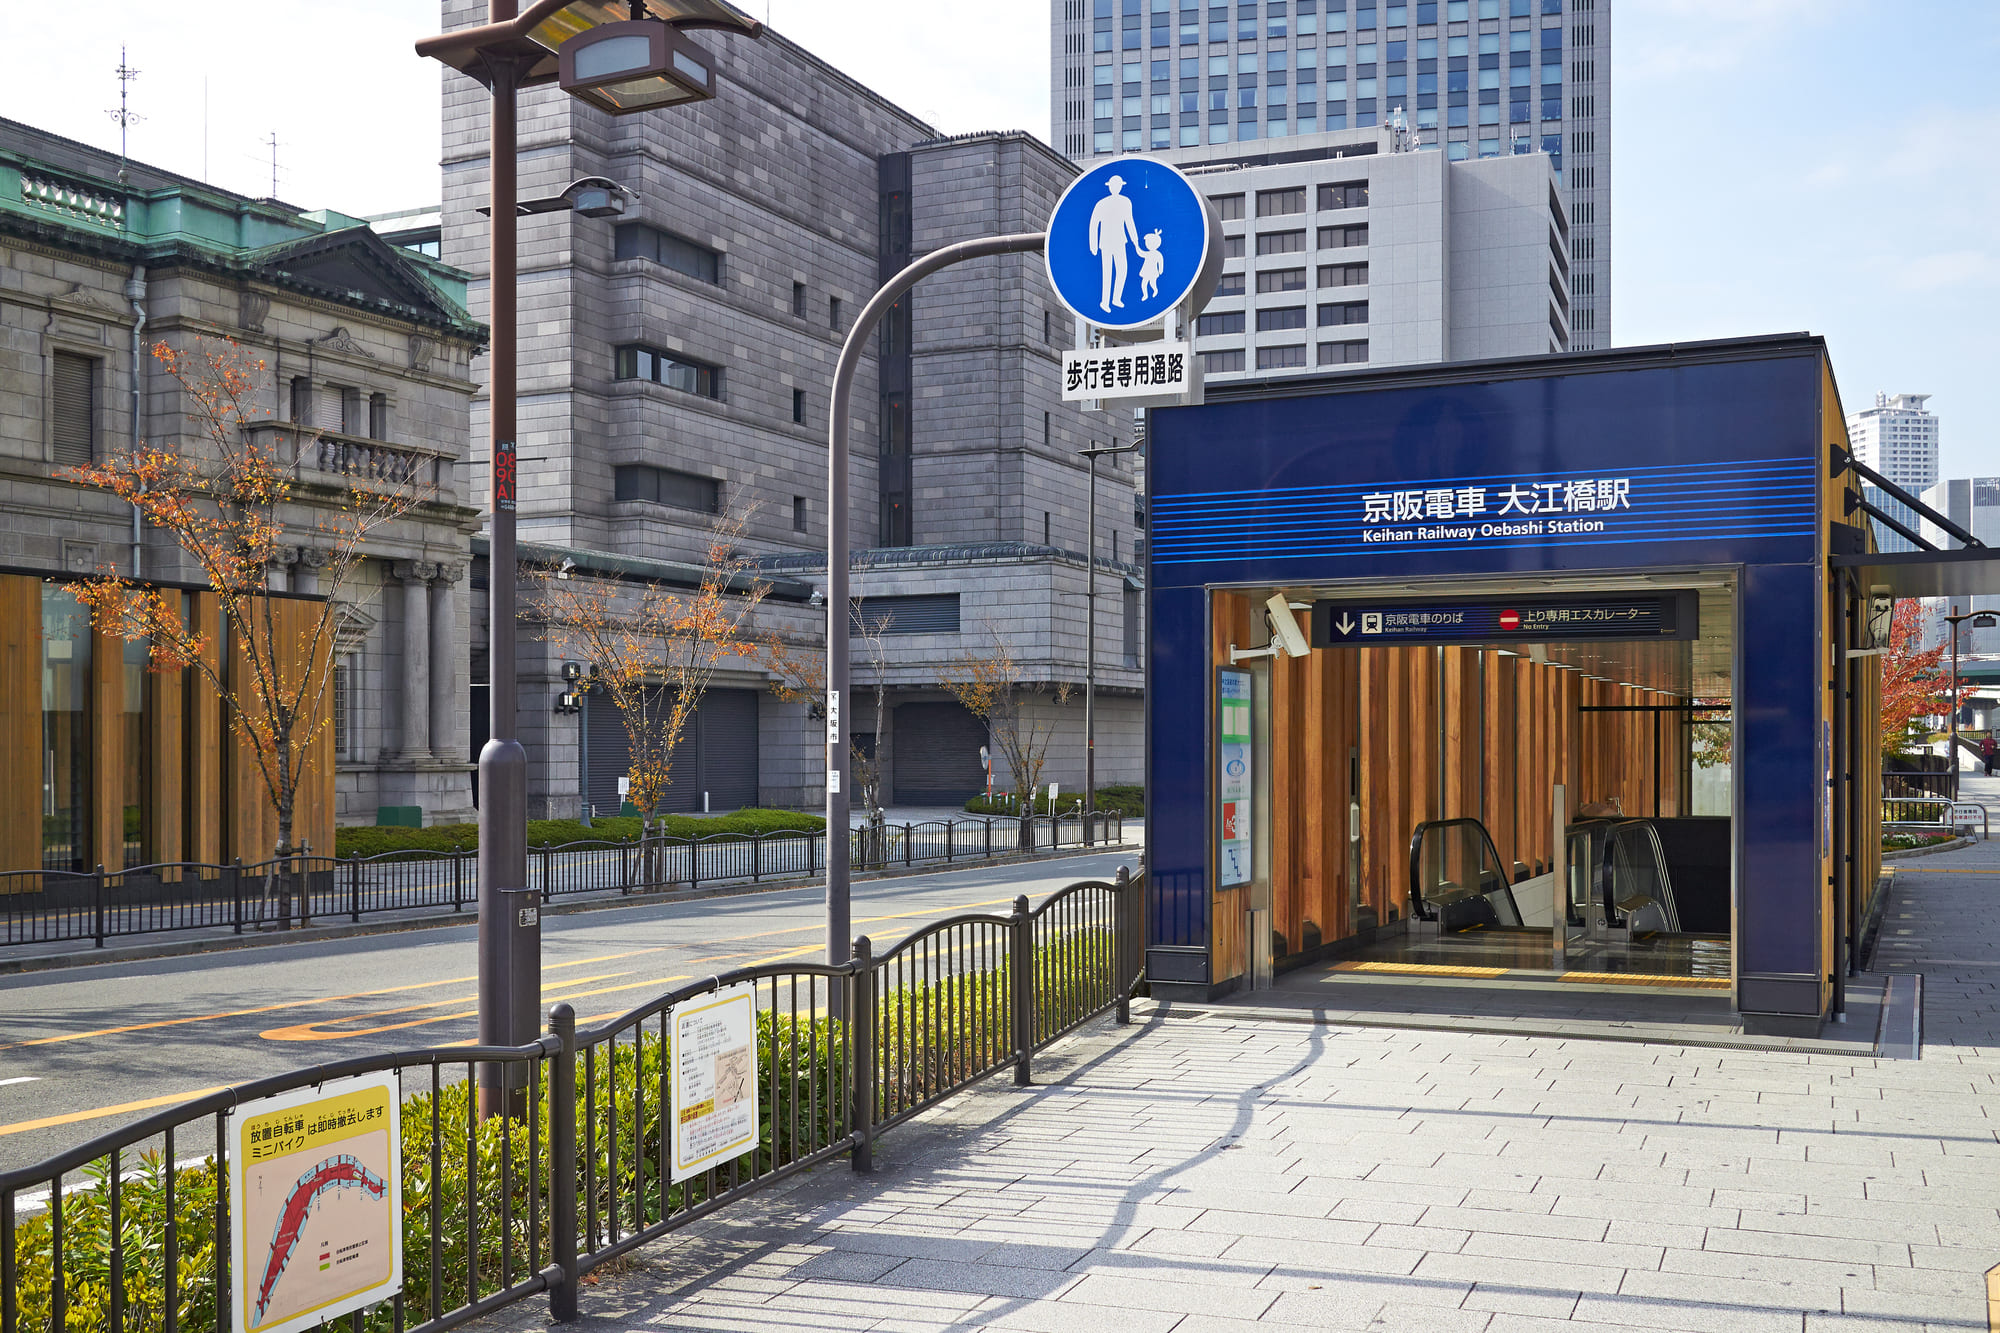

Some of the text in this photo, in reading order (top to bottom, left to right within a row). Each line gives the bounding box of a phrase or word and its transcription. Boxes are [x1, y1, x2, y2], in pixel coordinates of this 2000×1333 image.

[1067, 353, 1184, 392] 歩行者専用通路
[1362, 478, 1630, 523] 京阪電車 大江橋駅
[1363, 519, 1604, 542] Keihan Railway Oebashi Station
[1385, 608, 1650, 626] 京阪電車のりば 上り専用エスカレーター
[250, 1105, 384, 1144] 放置自転車 は即時撤去します
[252, 1136, 304, 1158] ミニバイク
